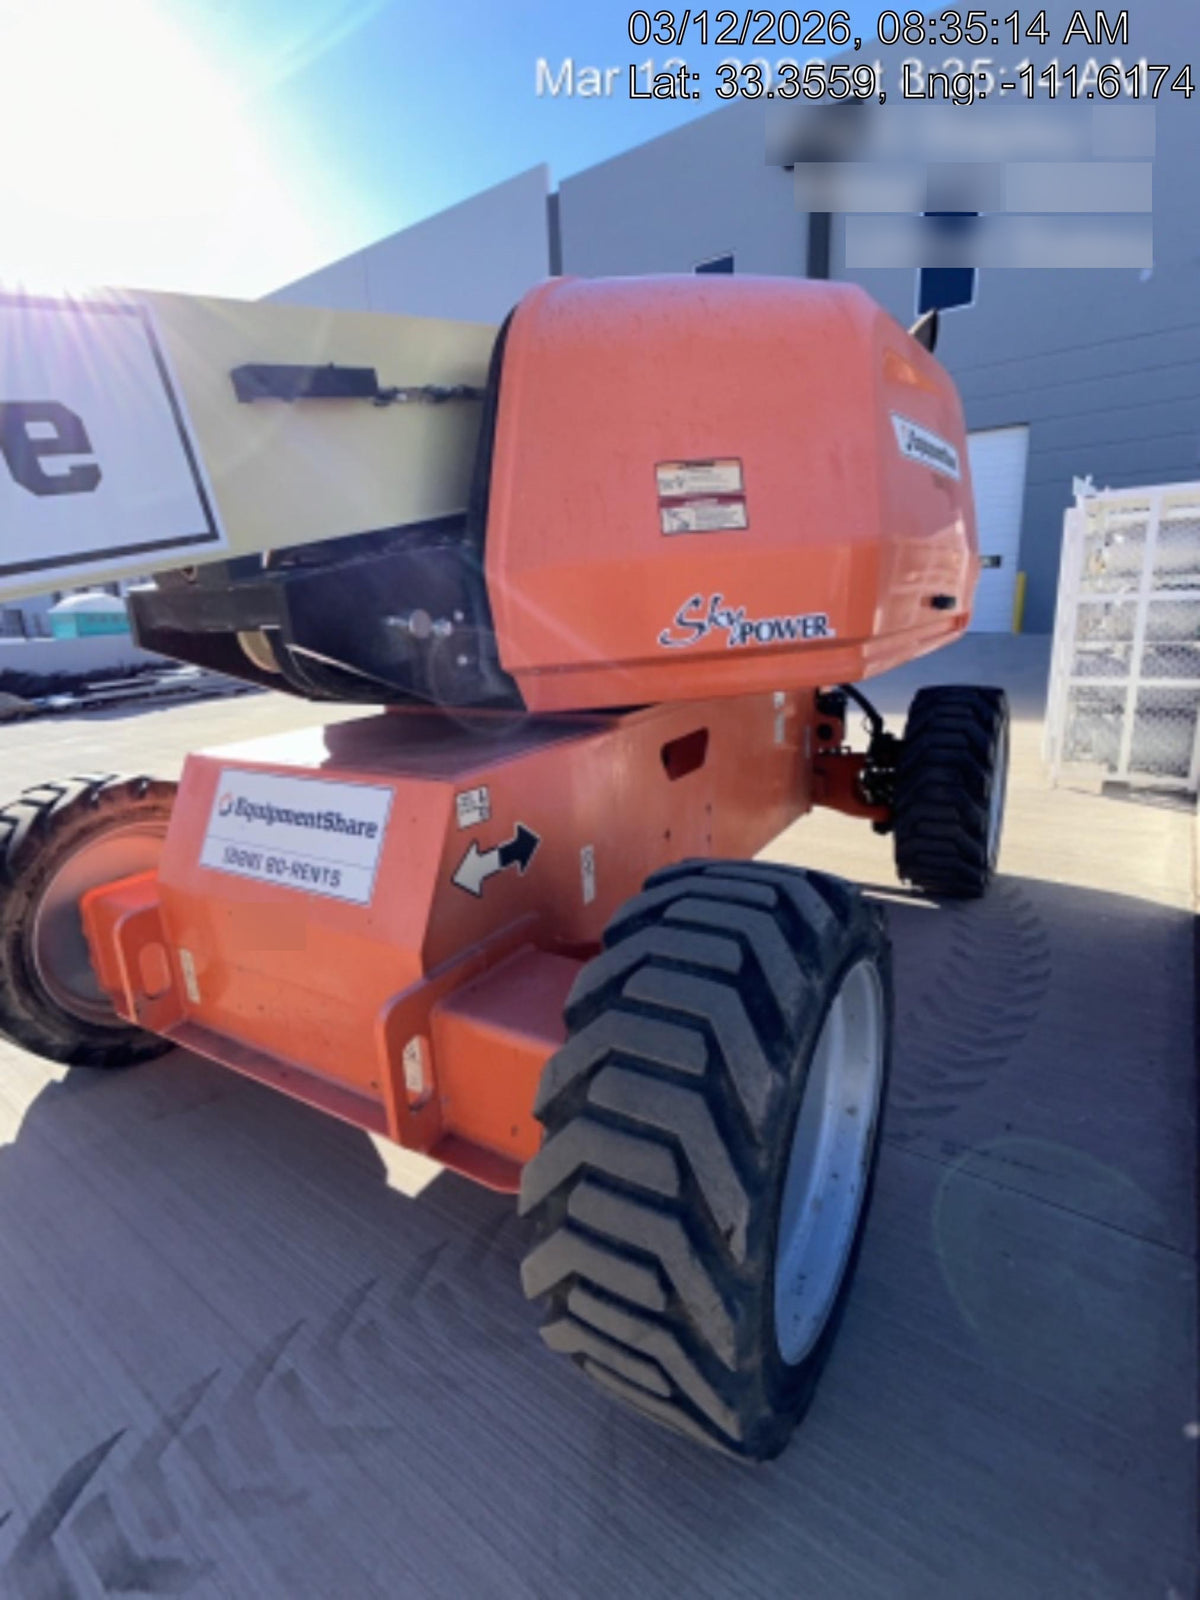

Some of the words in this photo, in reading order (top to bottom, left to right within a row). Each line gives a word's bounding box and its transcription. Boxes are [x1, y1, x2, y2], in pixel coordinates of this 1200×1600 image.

[658, 593, 745, 647] Sky
[738, 613, 830, 645] POWER
[234, 796, 379, 840] EquipmentShare
